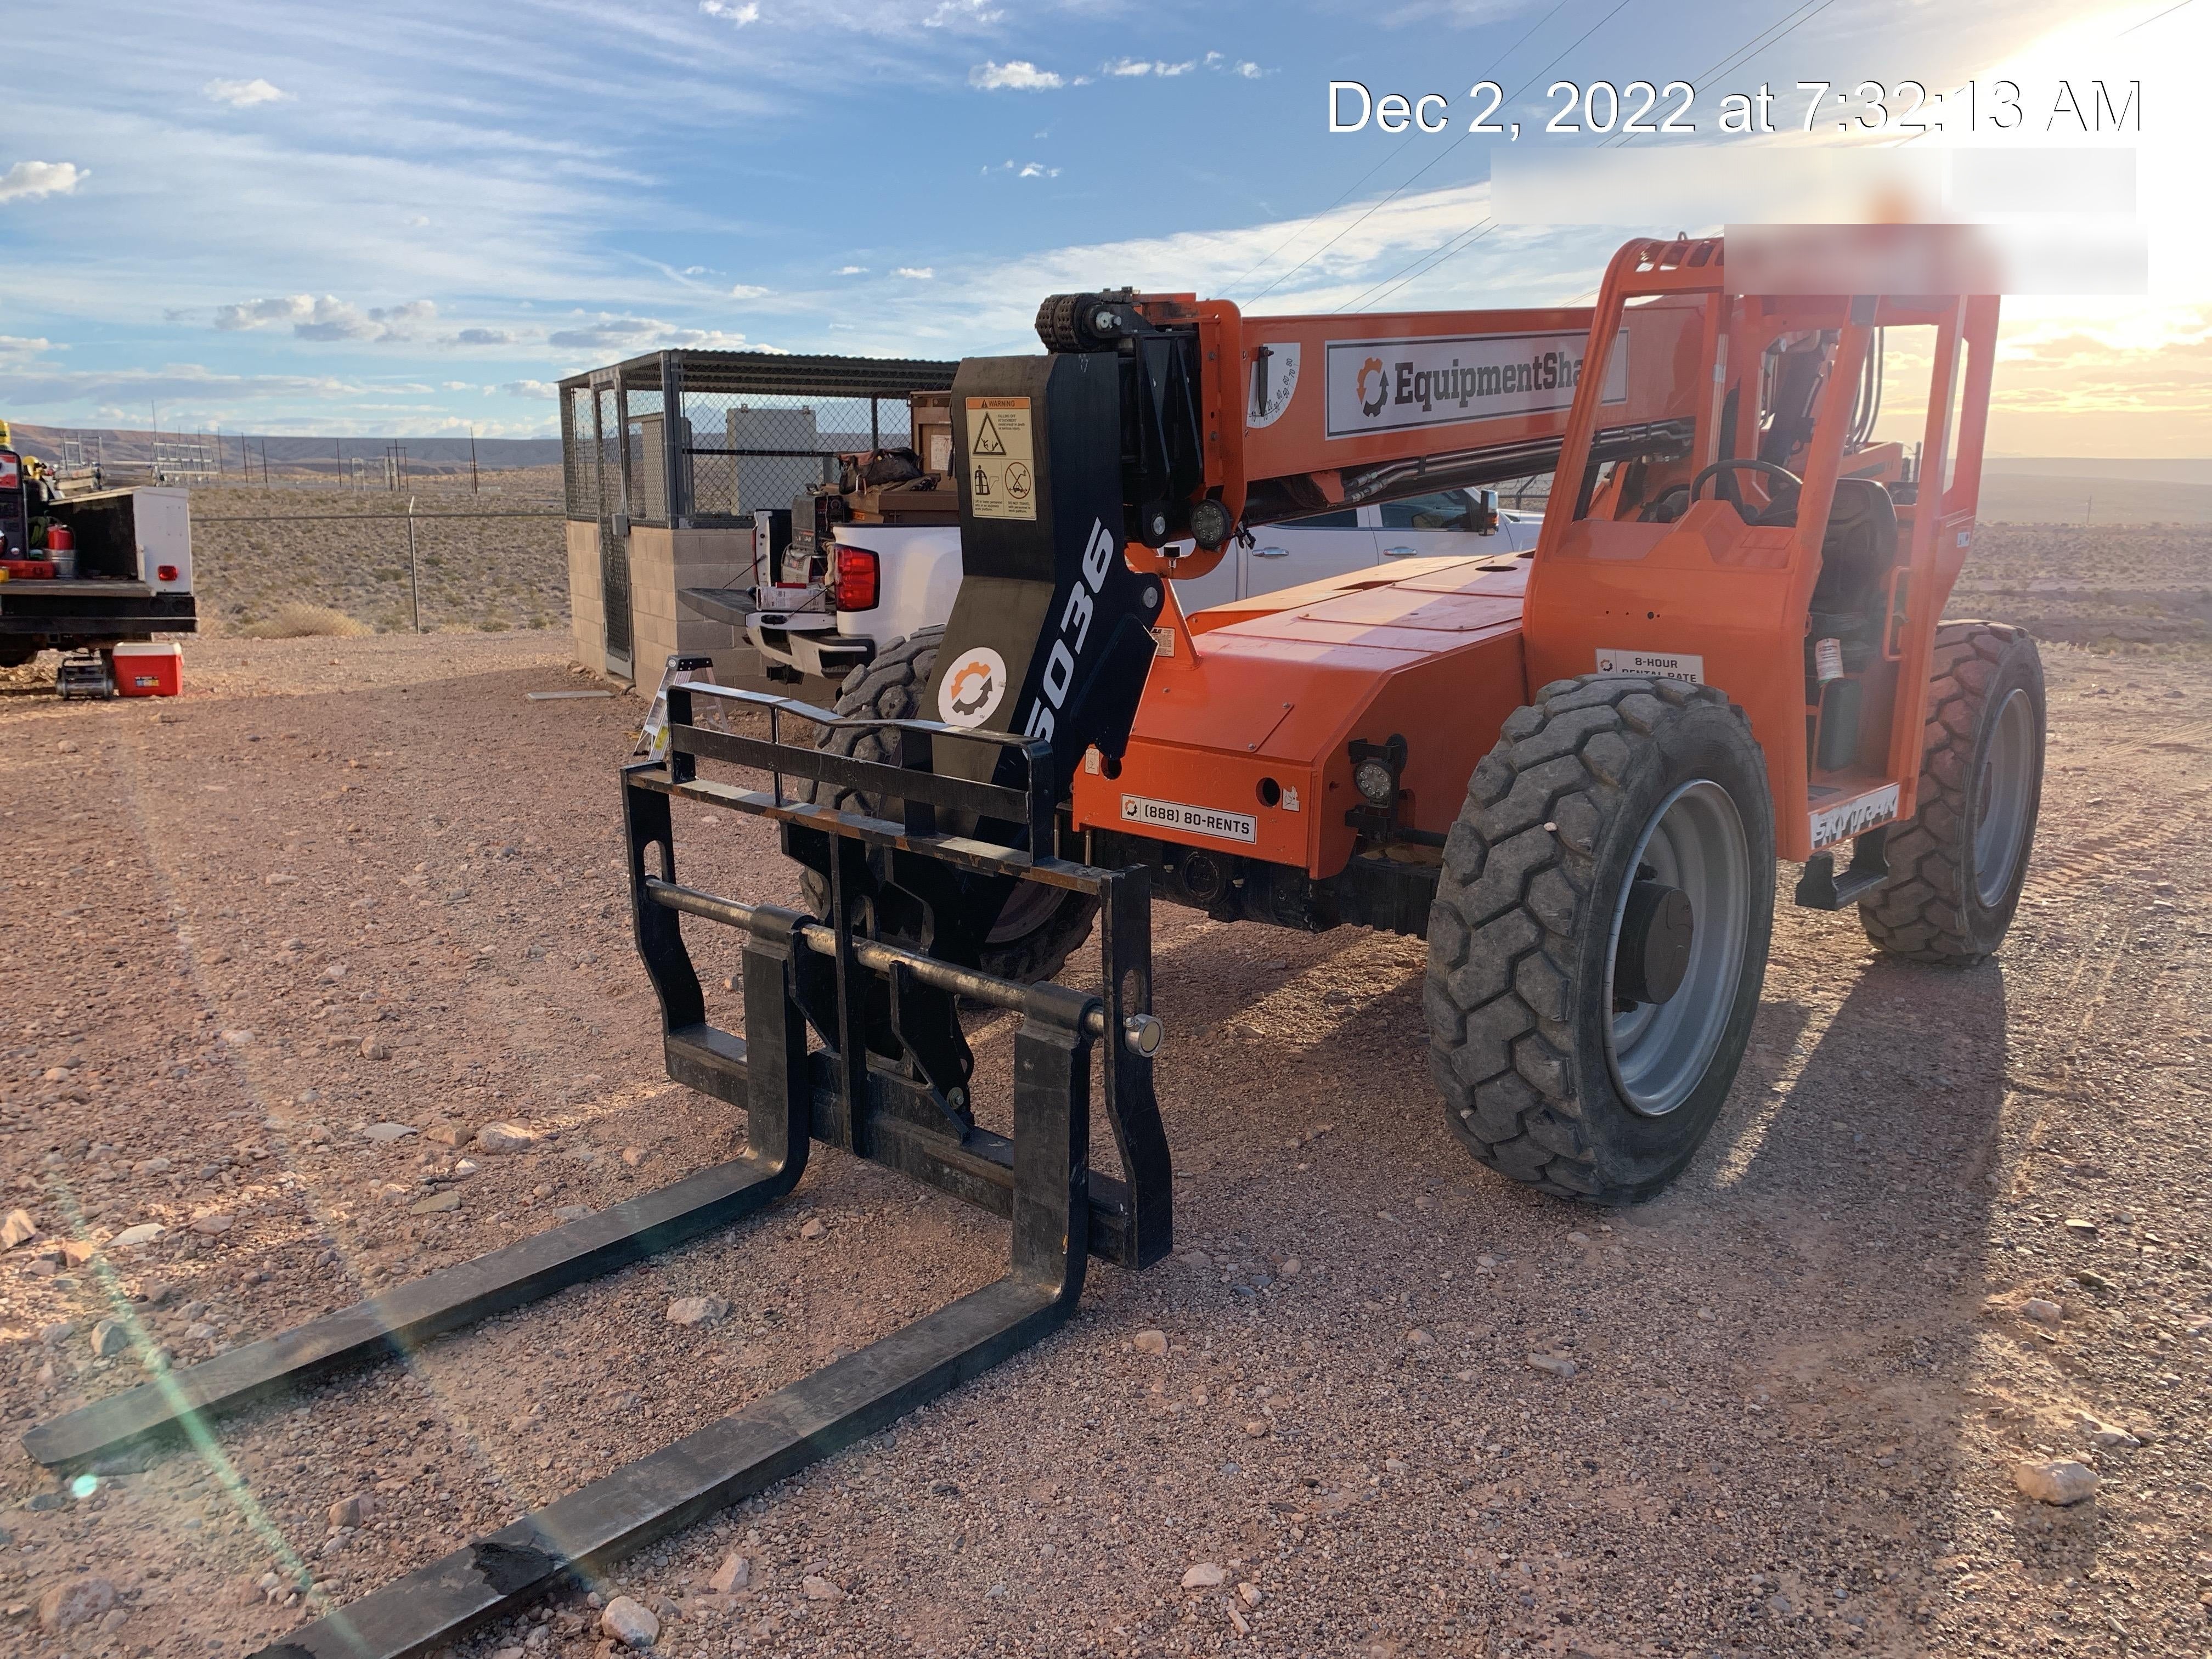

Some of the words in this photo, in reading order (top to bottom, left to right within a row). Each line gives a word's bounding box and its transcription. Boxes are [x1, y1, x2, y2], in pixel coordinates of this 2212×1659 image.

[1394, 351, 1584, 413] EquipmentSha
[1023, 517, 1114, 761] 5036
[1634, 657, 1678, 669] 8-HOUR
[1144, 804, 1180, 823] (888)
[1184, 812, 1250, 834] 80-RENTS
